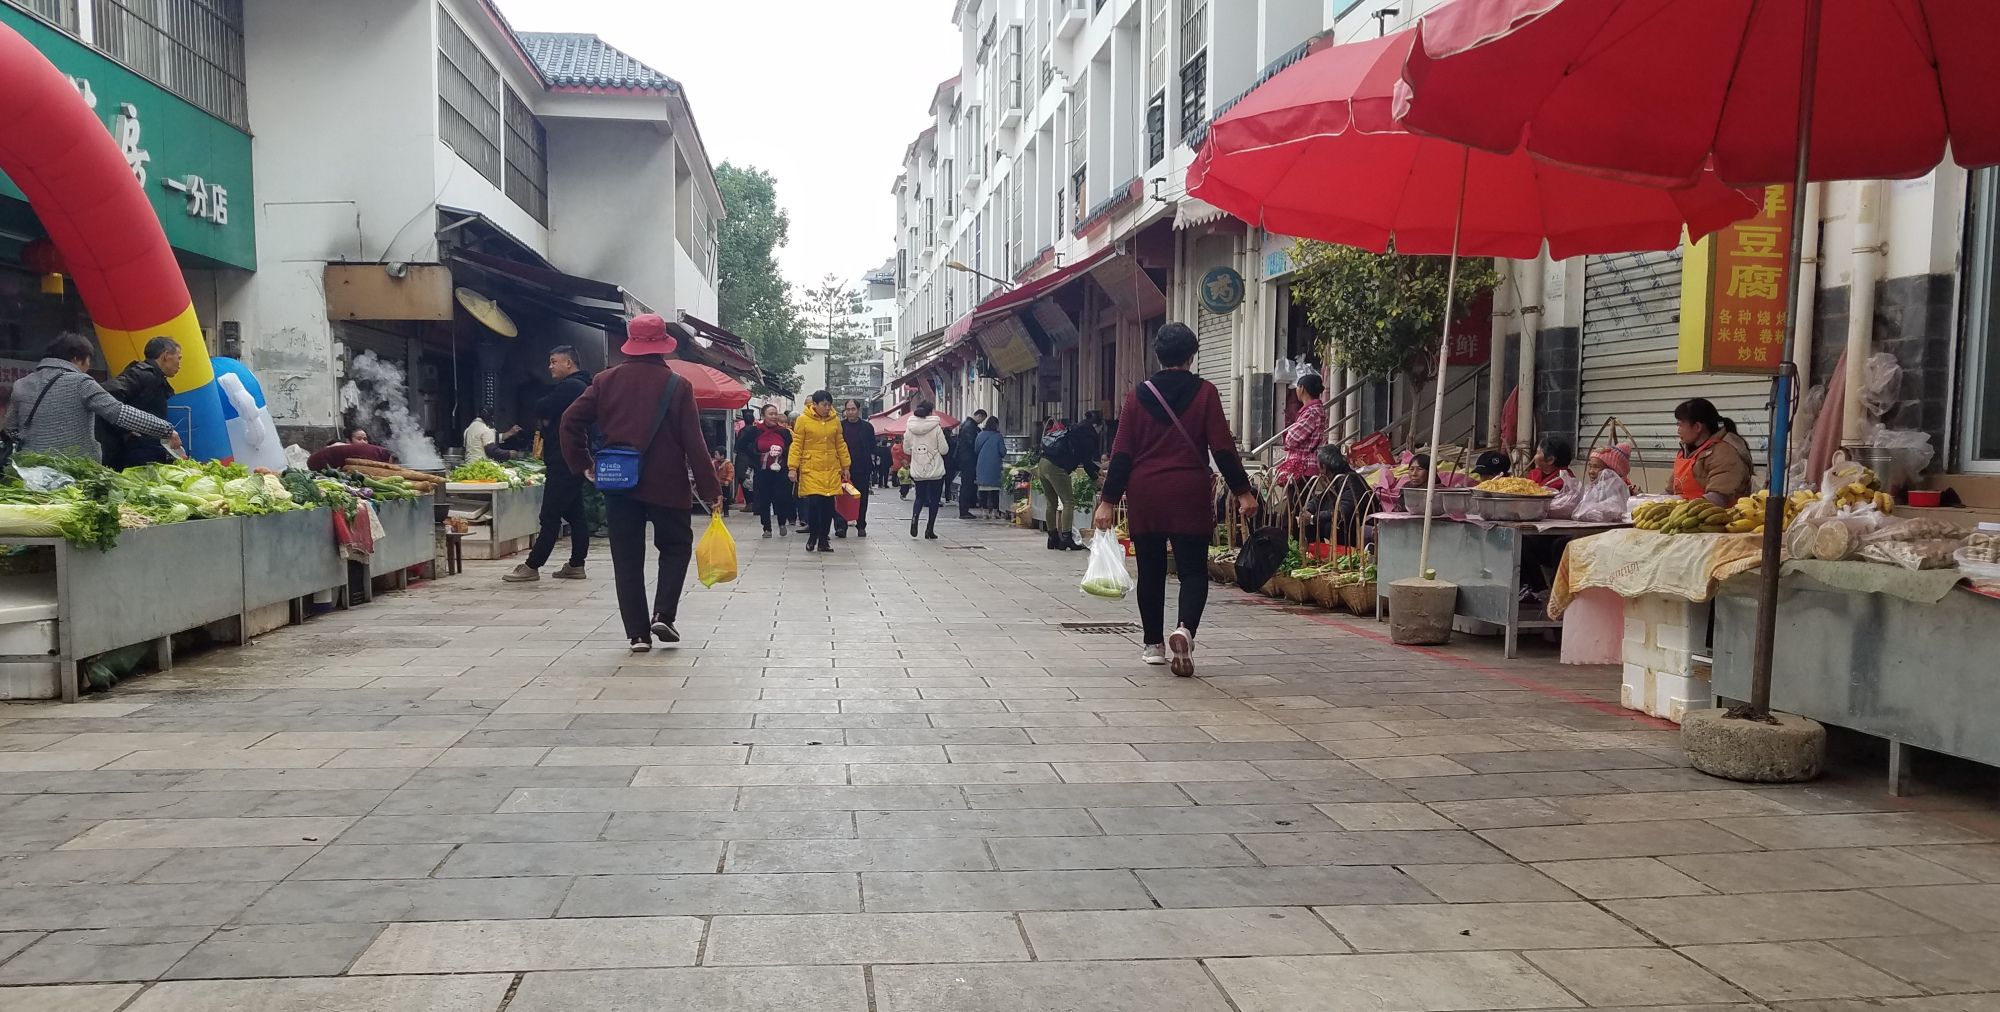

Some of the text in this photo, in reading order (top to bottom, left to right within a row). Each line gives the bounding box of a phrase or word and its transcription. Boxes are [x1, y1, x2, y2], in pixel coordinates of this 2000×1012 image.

[161, 174, 228, 225] 一分店
[1719, 309, 1787, 326] 各种烧烤
[1738, 346, 1767, 361] 炒饭
